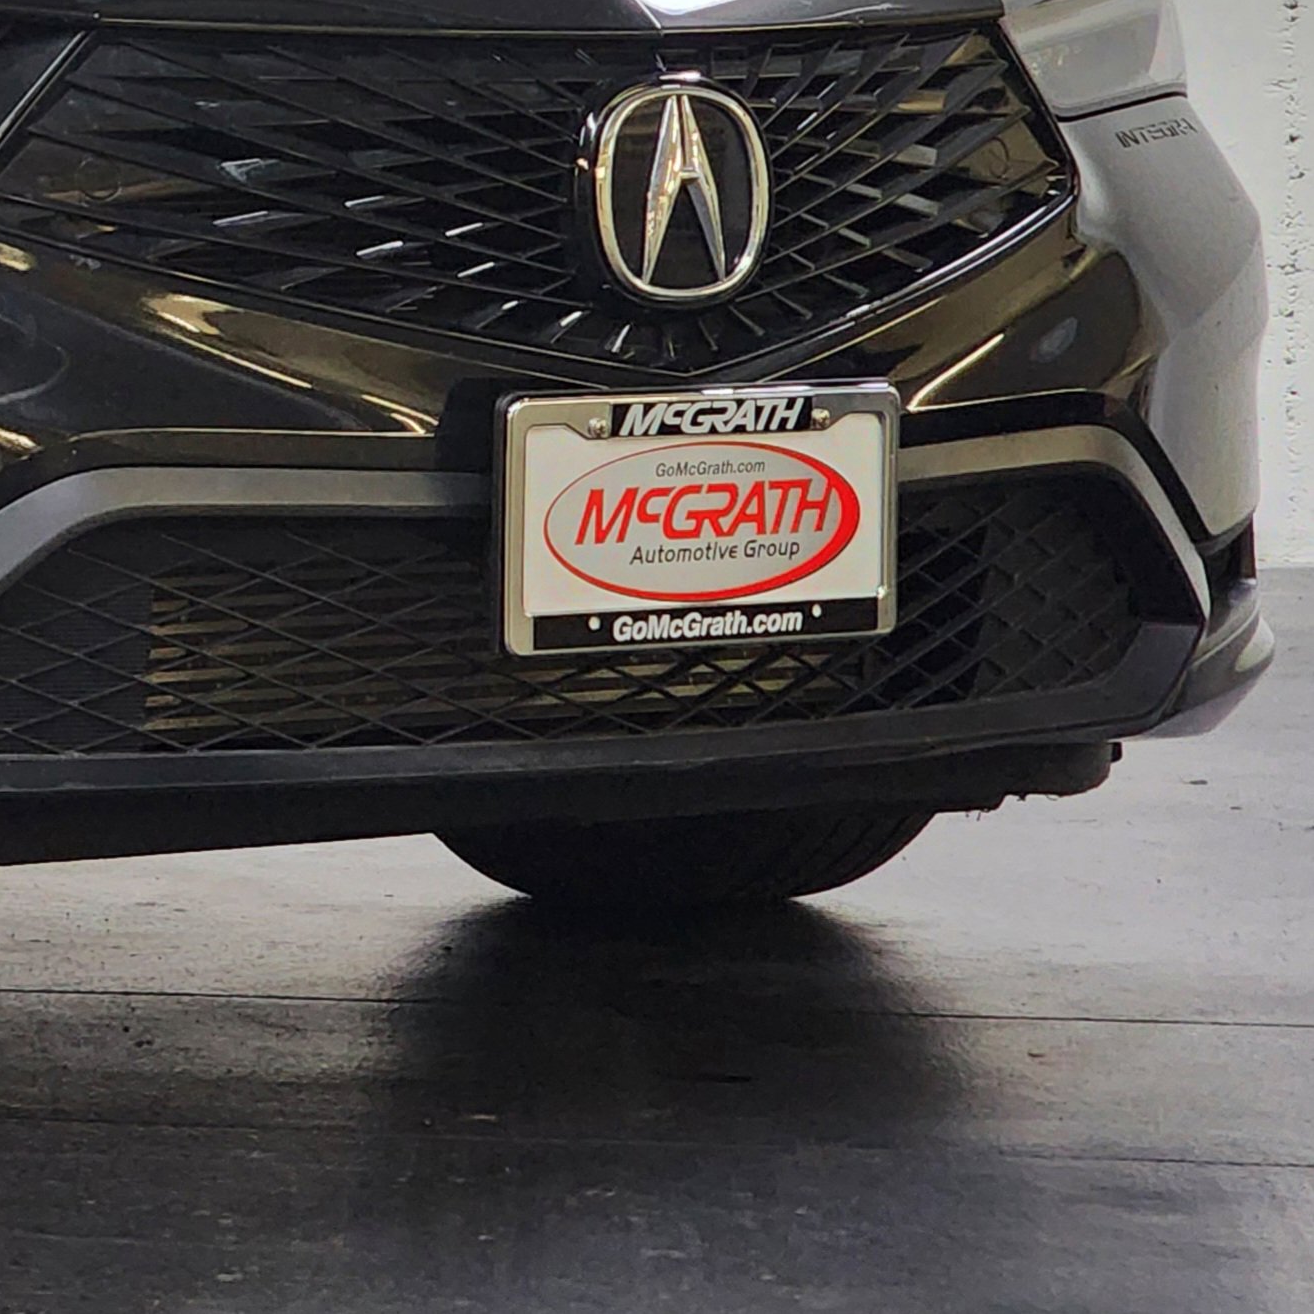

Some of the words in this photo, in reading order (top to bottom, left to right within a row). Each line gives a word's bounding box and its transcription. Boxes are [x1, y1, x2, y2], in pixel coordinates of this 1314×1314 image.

[655, 459, 766, 478] GoMcGrath.com
[629, 543, 739, 565] Automotive
[743, 540, 801, 562] Group
[612, 611, 803, 642] GoMcGrath.com
